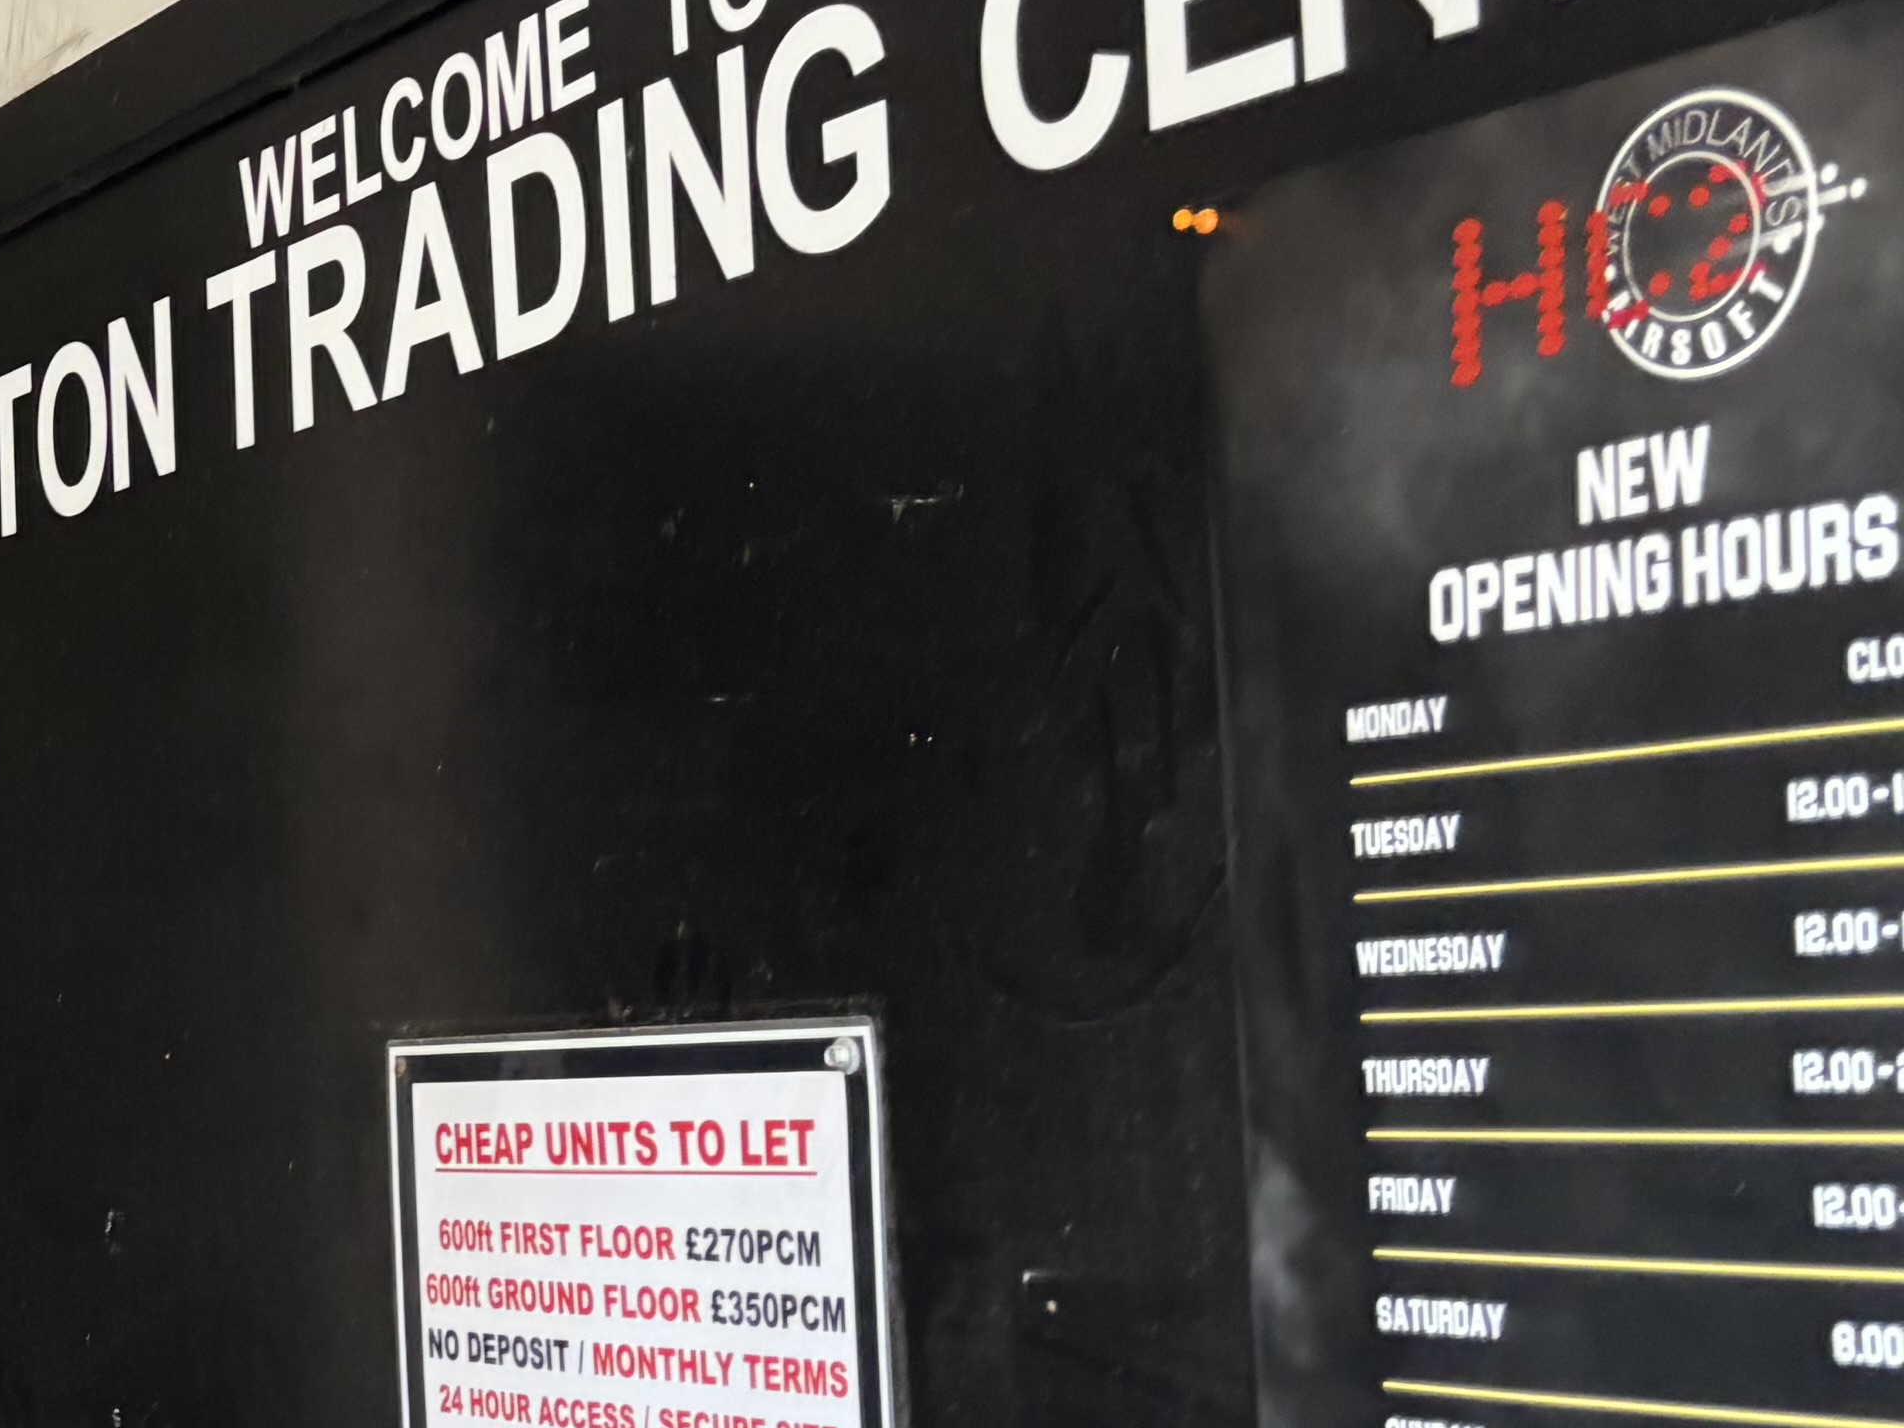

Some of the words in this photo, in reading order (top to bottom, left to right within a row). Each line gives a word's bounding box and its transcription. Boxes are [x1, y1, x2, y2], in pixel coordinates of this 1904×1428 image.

[206, 3, 892, 450] TRADING
[1577, 421, 1711, 526] NEW
[1428, 531, 1671, 644] OPENING
[1682, 493, 1901, 607] HOURS
[1346, 696, 1448, 742] MONDAY
[1350, 813, 1461, 857] TUESDAY
[1356, 931, 1506, 975] WEDNESDAY
[1362, 1057, 1490, 1095] THURSDAY
[435, 1121, 533, 1166] CHEAP
[545, 1120, 659, 1167] UNITS
[670, 1119, 725, 1167] TO
[740, 1118, 816, 1167] LET
[1368, 1176, 1456, 1215] FRIDAY
[439, 1218, 493, 1254] 600ft
[500, 1222, 570, 1256] FIRST
[580, 1224, 676, 1261] FLOOR
[686, 1227, 822, 1267] £270PCM
[426, 1273, 481, 1308] 600ft
[488, 1277, 593, 1316] GROUND
[603, 1283, 701, 1323] FLOOR
[712, 1290, 847, 1333] £350PCM
[1375, 1294, 1506, 1340] SATURDAY
[428, 1327, 460, 1362] NO
[467, 1331, 569, 1373] DEPOSIT
[593, 1343, 734, 1387] MONTHLY
[743, 1354, 848, 1399] TERMS
[439, 1384, 464, 1416] 24
[469, 1388, 532, 1424] HOUR
